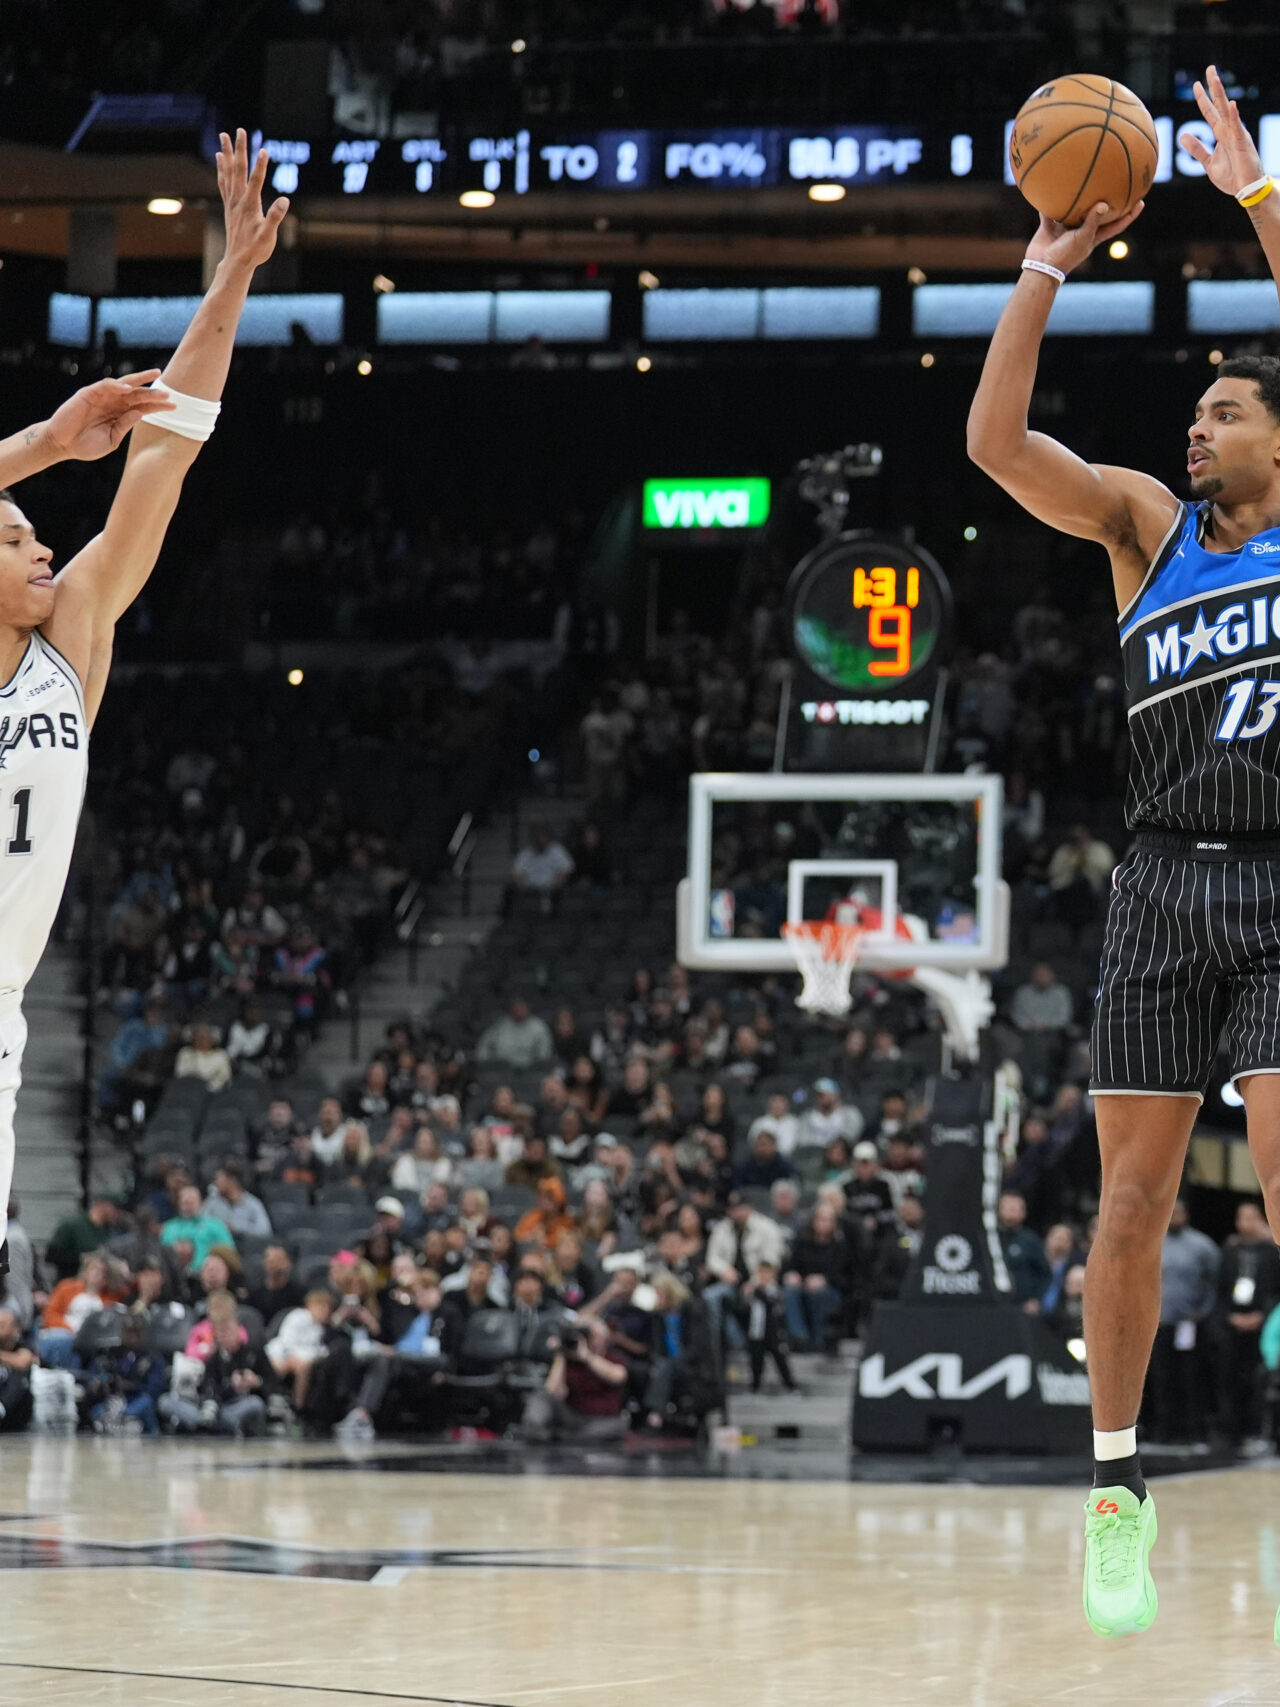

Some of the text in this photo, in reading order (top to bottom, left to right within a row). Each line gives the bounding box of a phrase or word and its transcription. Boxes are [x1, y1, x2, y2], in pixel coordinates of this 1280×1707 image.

[540, 145, 599, 181] TO
[665, 142, 767, 178] FG%
[865, 139, 922, 174] PF
[852, 566, 920, 609] 1:31
[868, 604, 911, 677] 9
[858, 1352, 1032, 1401] KIA
